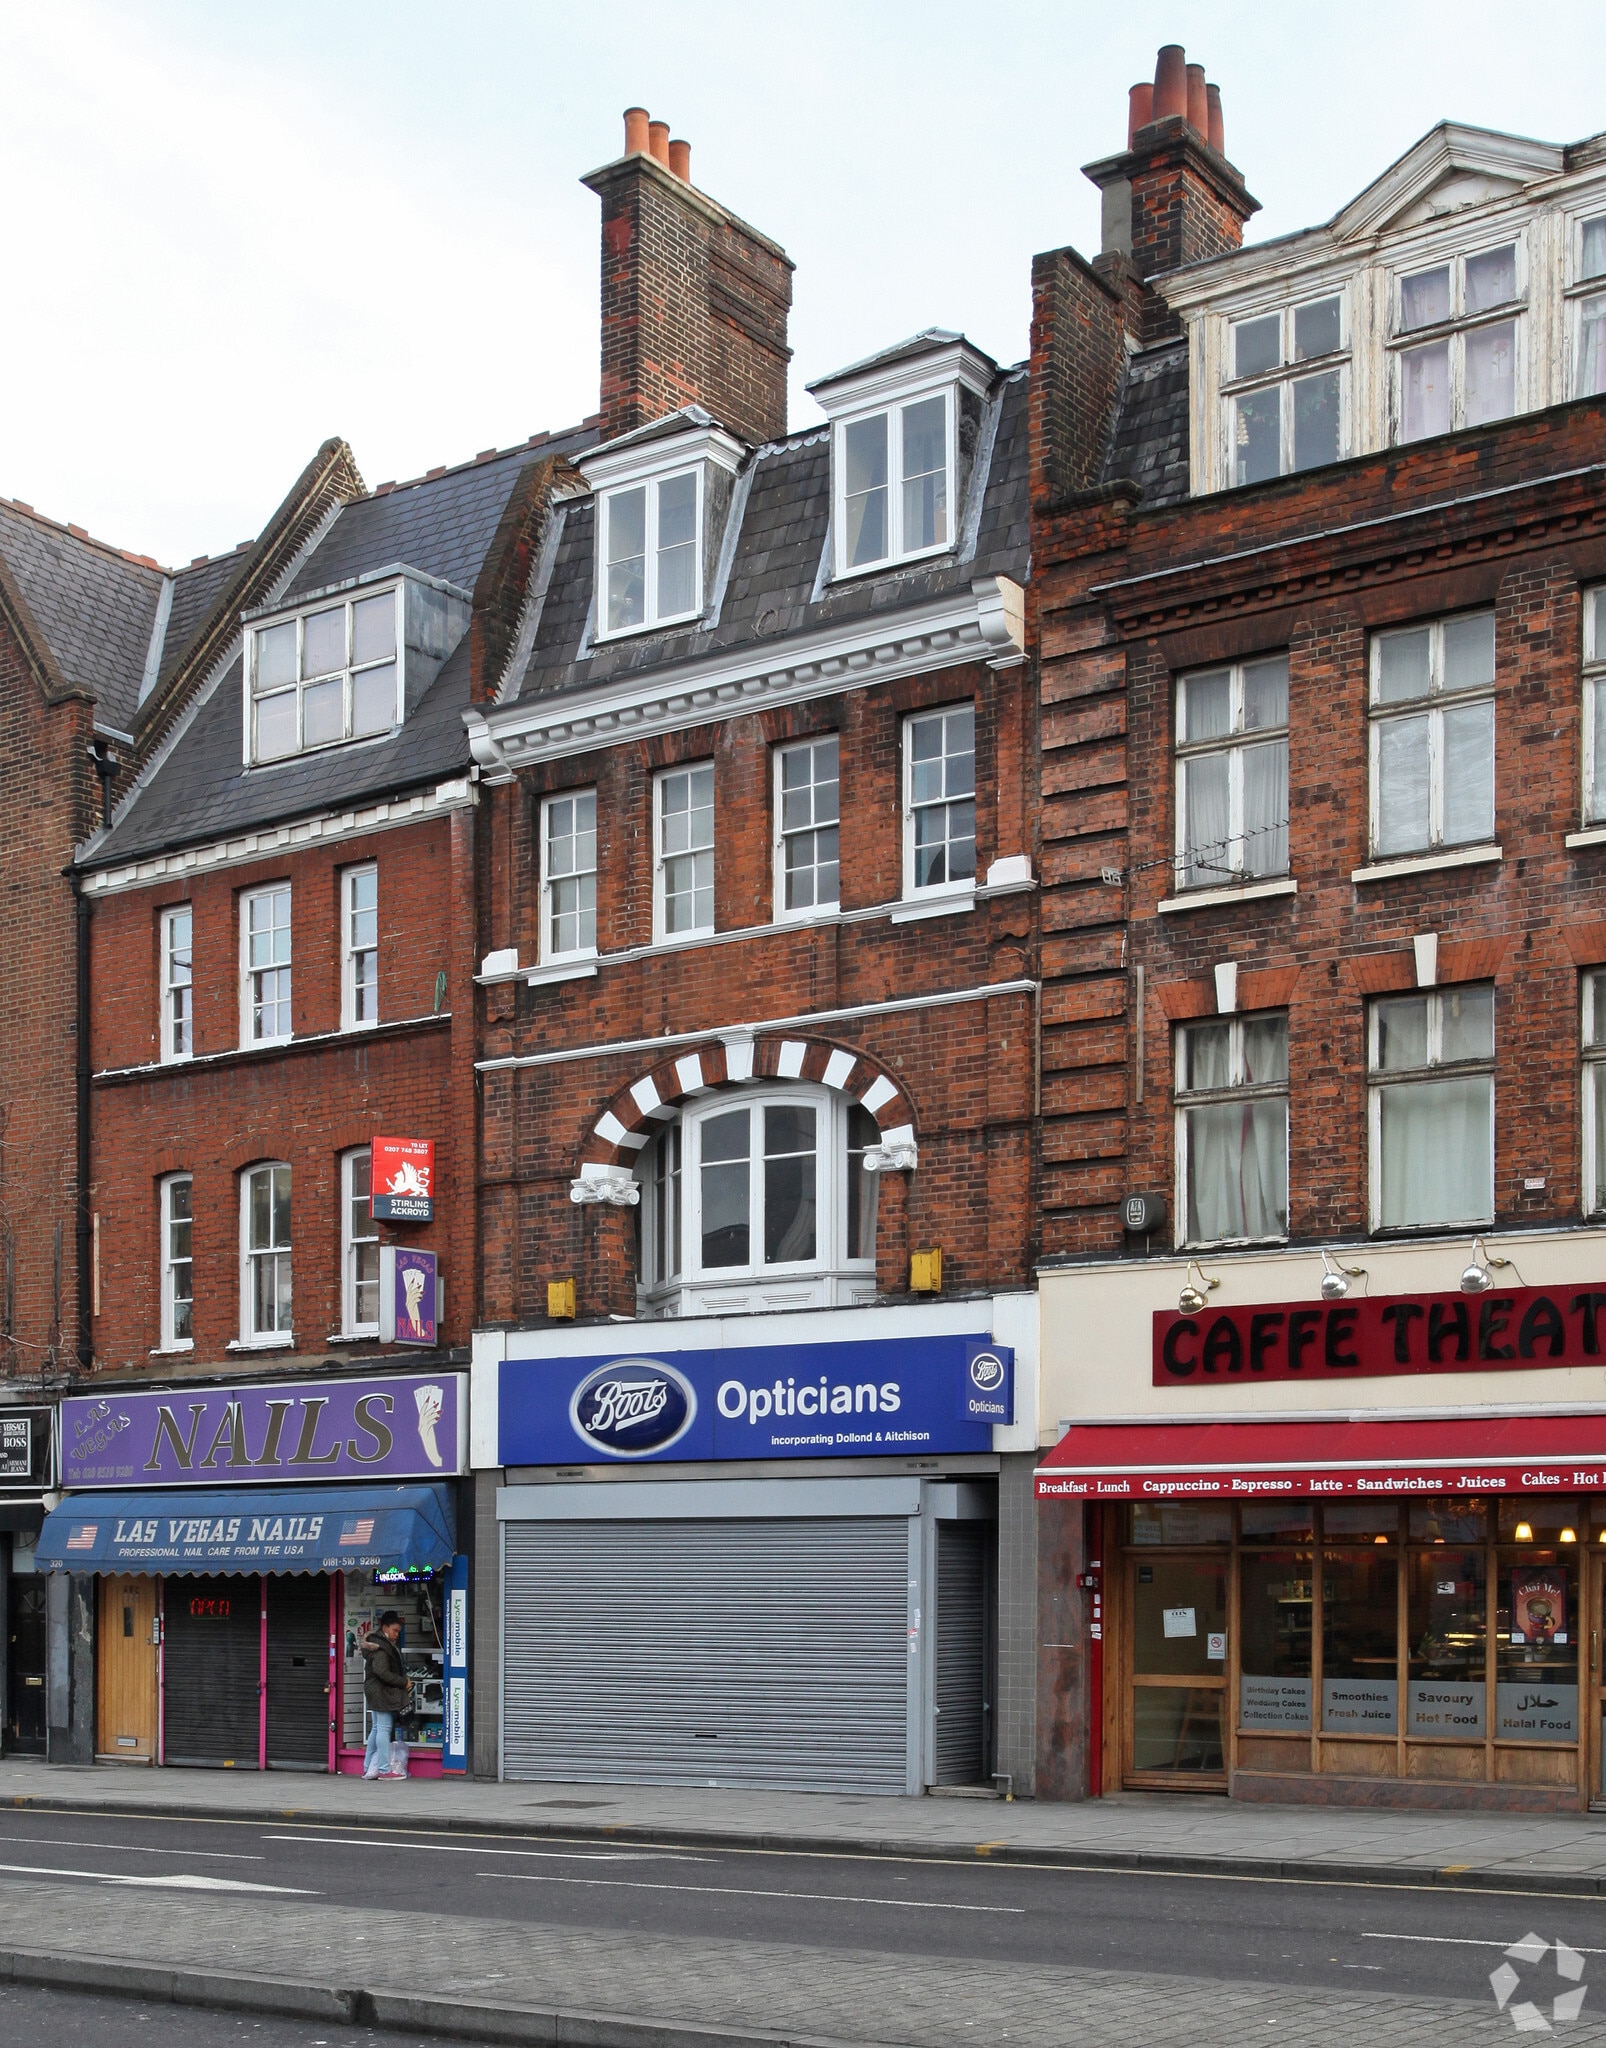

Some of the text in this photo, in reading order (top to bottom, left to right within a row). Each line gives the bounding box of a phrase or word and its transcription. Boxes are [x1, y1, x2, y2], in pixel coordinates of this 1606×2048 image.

[391, 1199, 429, 1208] STIRLING
[391, 1207, 429, 1217] ACKROYD
[397, 1317, 435, 1340] NAILS
[1163, 1308, 1359, 1377] CAFFE
[975, 1360, 998, 1381] Boots
[585, 1376, 901, 1432] Boots Opticians
[969, 1399, 1005, 1414] Opticians
[73, 1401, 111, 1438] LAS
[3, 1423, 26, 1431] VERSACE
[143, 1392, 395, 1472] NAILS
[70, 1410, 131, 1460] VEGAS
[771, 1430, 930, 1446] incorporating Dollond & Aitchison
[3, 1437, 27, 1448] BOSS
[1142, 1479, 1220, 1494] Cappuccino
[1231, 1479, 1293, 1492] Espresso
[1310, 1479, 1343, 1491] latte
[1357, 1476, 1443, 1490] Sandwiches
[1456, 1475, 1506, 1489] Juices
[1521, 1472, 1560, 1485] Cakes
[1573, 1471, 1599, 1485] Hot
[1038, 1480, 1087, 1494] Breakfast
[1097, 1480, 1130, 1493] Lunch
[113, 1516, 324, 1543] LAS VEGAS NAILS
[118, 1545, 304, 1557] PROFESSIONAL NAIL CARE FROM THE USA
[50, 1560, 63, 1568] 320
[322, 1556, 380, 1567] 0181-510 9280
[1518, 1583, 1561, 1597] Chai Me!
[454, 1598, 462, 1656] Lycamobile
[1247, 1686, 1306, 1696] Birthday Cakes
[1331, 1691, 1389, 1702] Smoothies
[1246, 1699, 1306, 1708] Wedding Cakes
[1418, 1692, 1474, 1706] Savoury
[453, 1687, 461, 1744] Lycamobile
[1243, 1711, 1309, 1721] Collection Cakes
[1328, 1708, 1391, 1719] Fresh Juice
[1416, 1713, 1478, 1725] Hot Food
[1503, 1718, 1571, 1730] Halal Food
